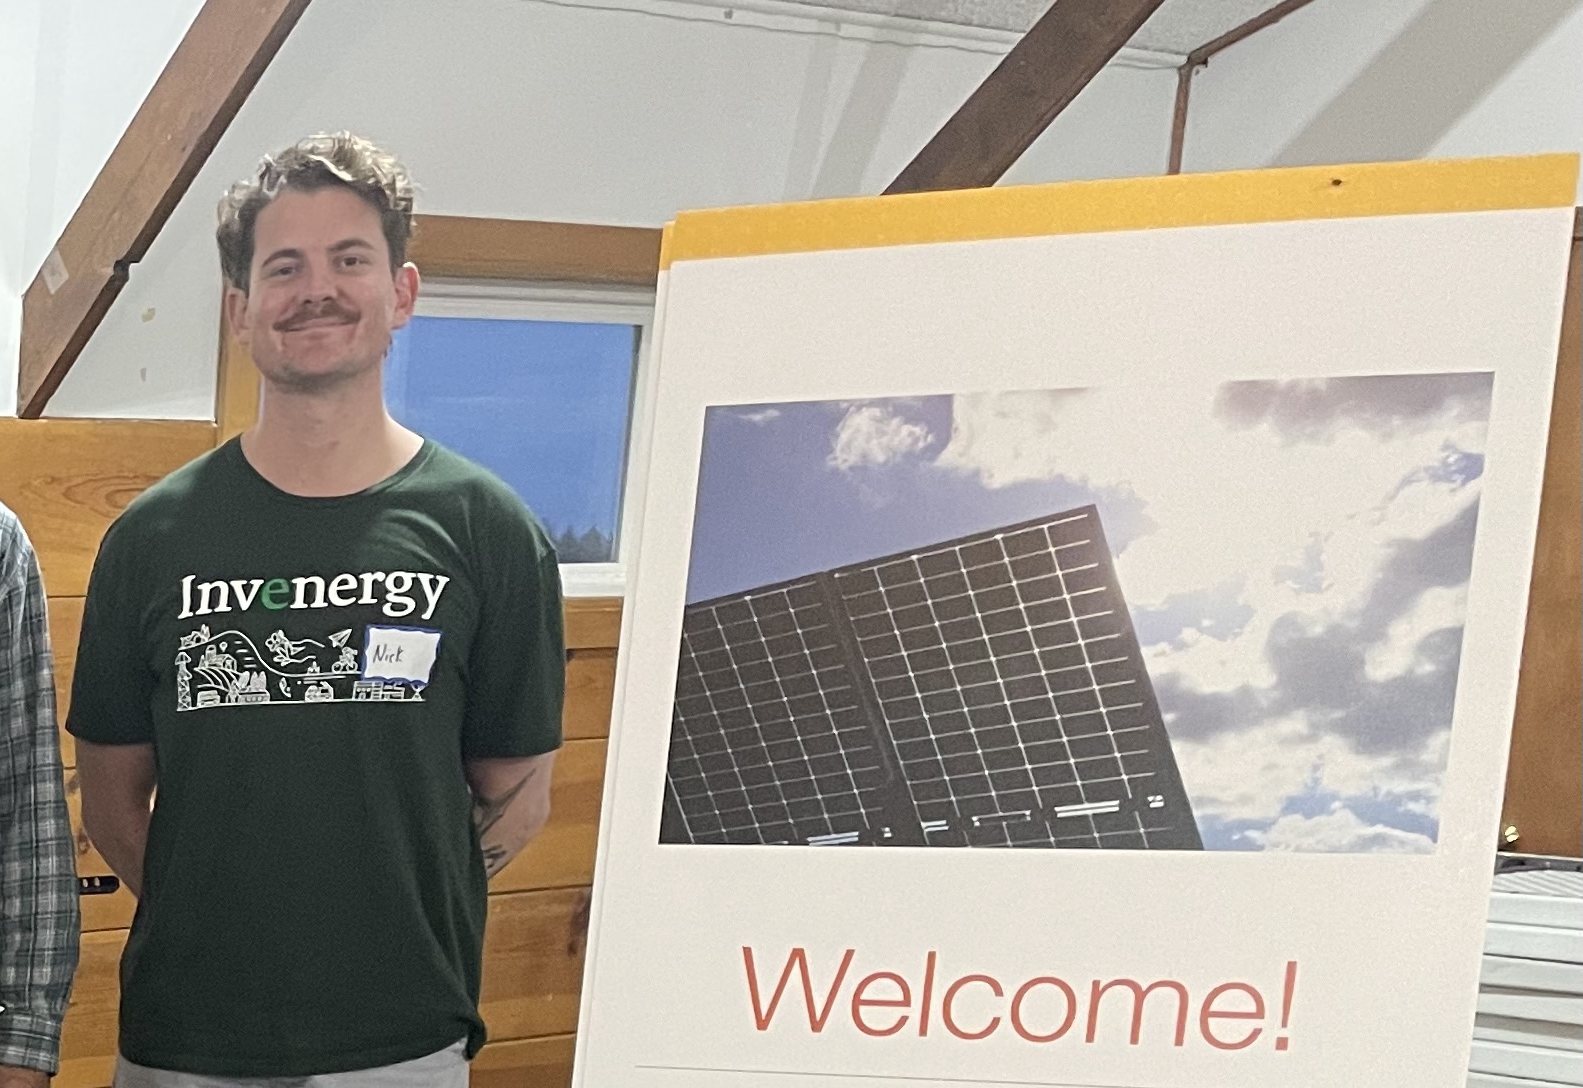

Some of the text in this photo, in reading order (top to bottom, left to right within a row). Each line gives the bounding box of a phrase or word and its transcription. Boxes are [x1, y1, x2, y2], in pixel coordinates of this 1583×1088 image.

[177, 570, 450, 620] Invenergy
[373, 644, 404, 663] Nick
[741, 945, 1299, 1052] Welcome!
